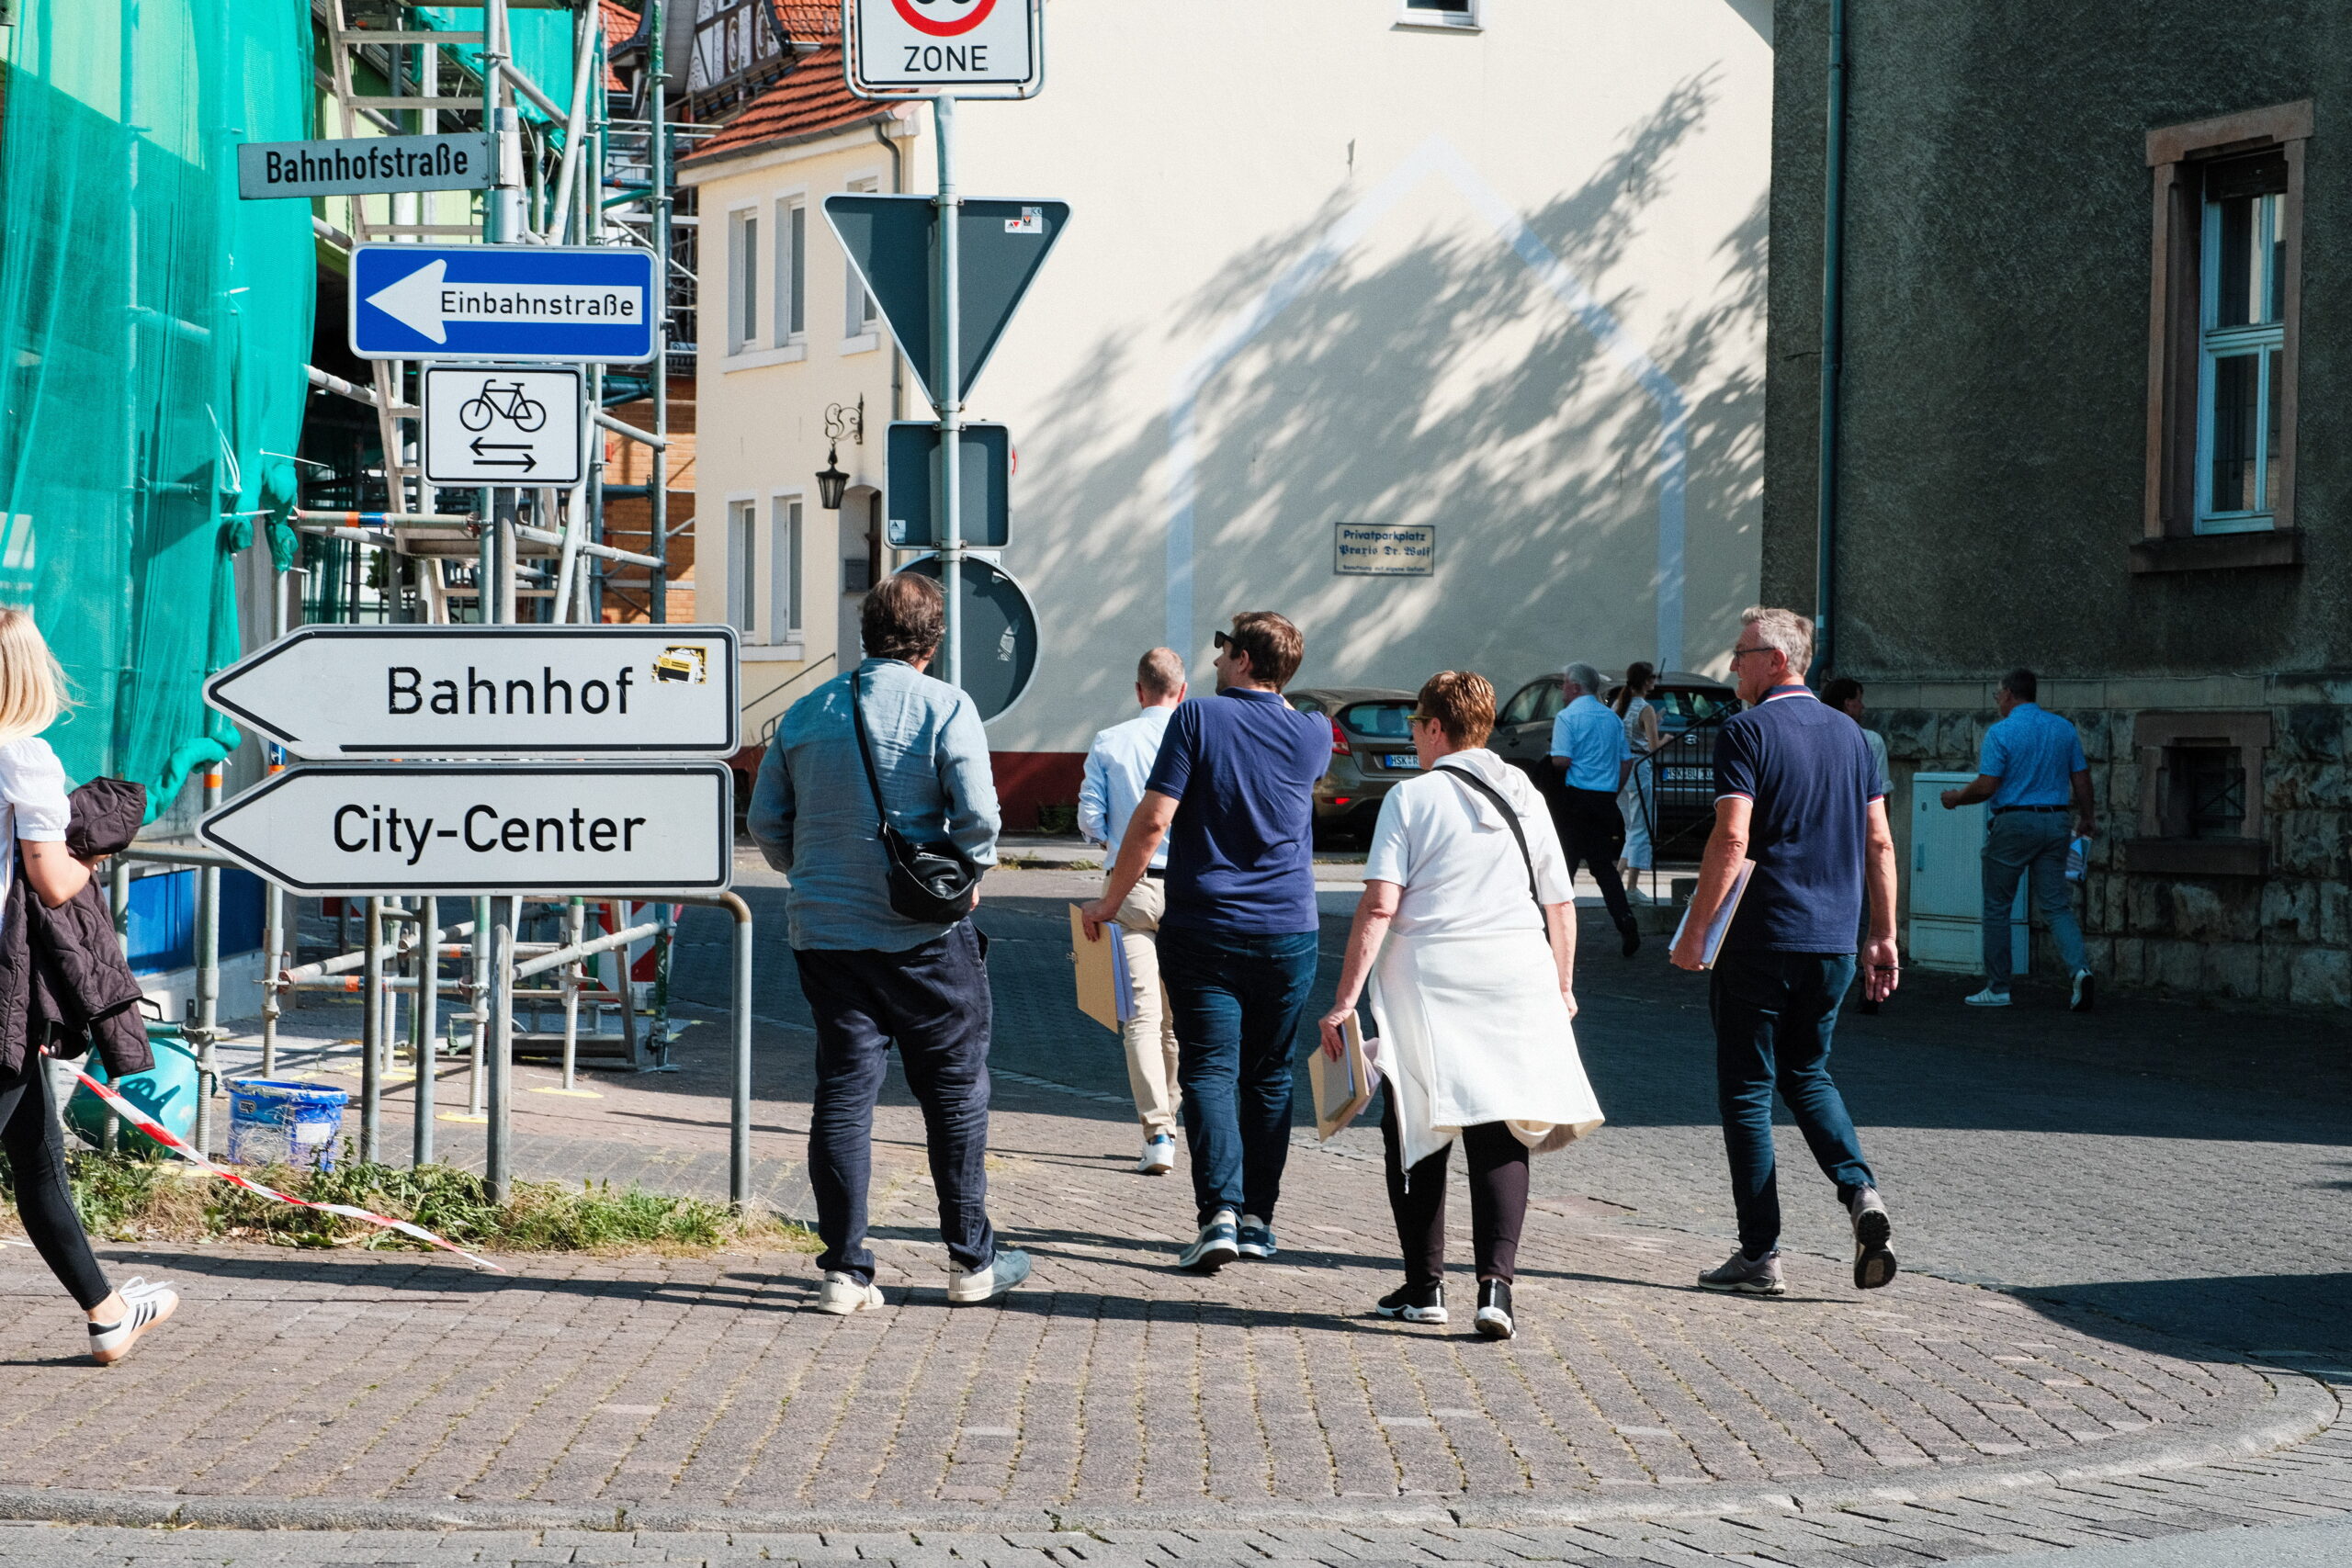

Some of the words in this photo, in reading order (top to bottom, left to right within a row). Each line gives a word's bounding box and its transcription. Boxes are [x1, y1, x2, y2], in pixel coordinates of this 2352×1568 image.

[903, 45, 989, 73] ZONE
[266, 142, 469, 184] Bahnhofstraße
[441, 290, 634, 318] Einbahnstraße
[1343, 530, 1426, 542] Privatparkplatz
[1339, 544, 1378, 557] Praxis
[1384, 546, 1402, 556] Dr.
[1404, 546, 1431, 558] Wolf
[388, 666, 634, 716] Bahnhof
[1390, 756, 1407, 765] HSK
[333, 804, 647, 866] City-Center
